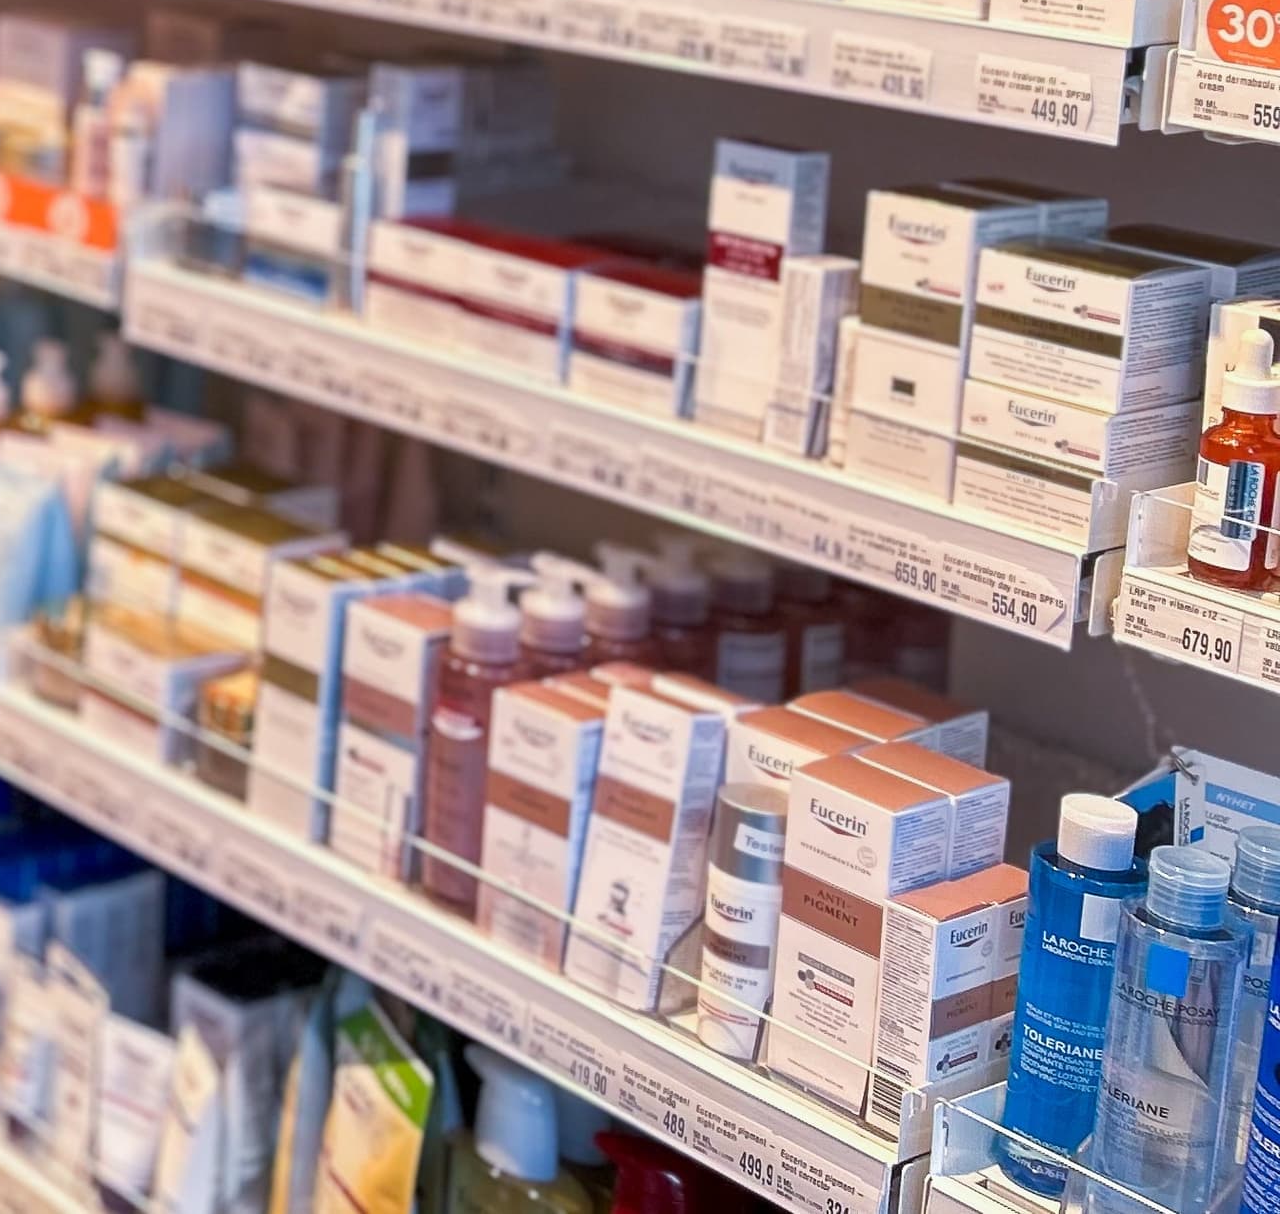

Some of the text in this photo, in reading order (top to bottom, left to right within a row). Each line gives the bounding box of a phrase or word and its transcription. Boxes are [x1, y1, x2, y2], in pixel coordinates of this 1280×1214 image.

[1217, 4, 1280, 49] 30
[1031, 98, 1078, 127] 449,90
[1026, 267, 1076, 291] Eucerin
[1007, 399, 1057, 425] Eucerin
[895, 561, 936, 594] 659,90
[991, 592, 1037, 626] 554,90
[1130, 598, 1156, 612] serum
[1170, 599, 1199, 615] vitamin
[1182, 627, 1232, 663] 679,90
[748, 745, 793, 775] Euceri
[810, 798, 867, 835] Eucerin
[1215, 793, 1257, 811] NYHET
[711, 893, 753, 921] Eucerin
[803, 894, 858, 927] PIGMENT
[817, 889, 852, 909] ANTI-
[950, 922, 989, 945] Eucerin
[1043, 930, 1116, 959] LA ROCHE-
[1023, 1023, 1104, 1060] TOLERIANE
[570, 1060, 607, 1096] 419,90
[1065, 1064, 1101, 1077] PROTEC
[1103, 1080, 1170, 1120] OLERIANE
